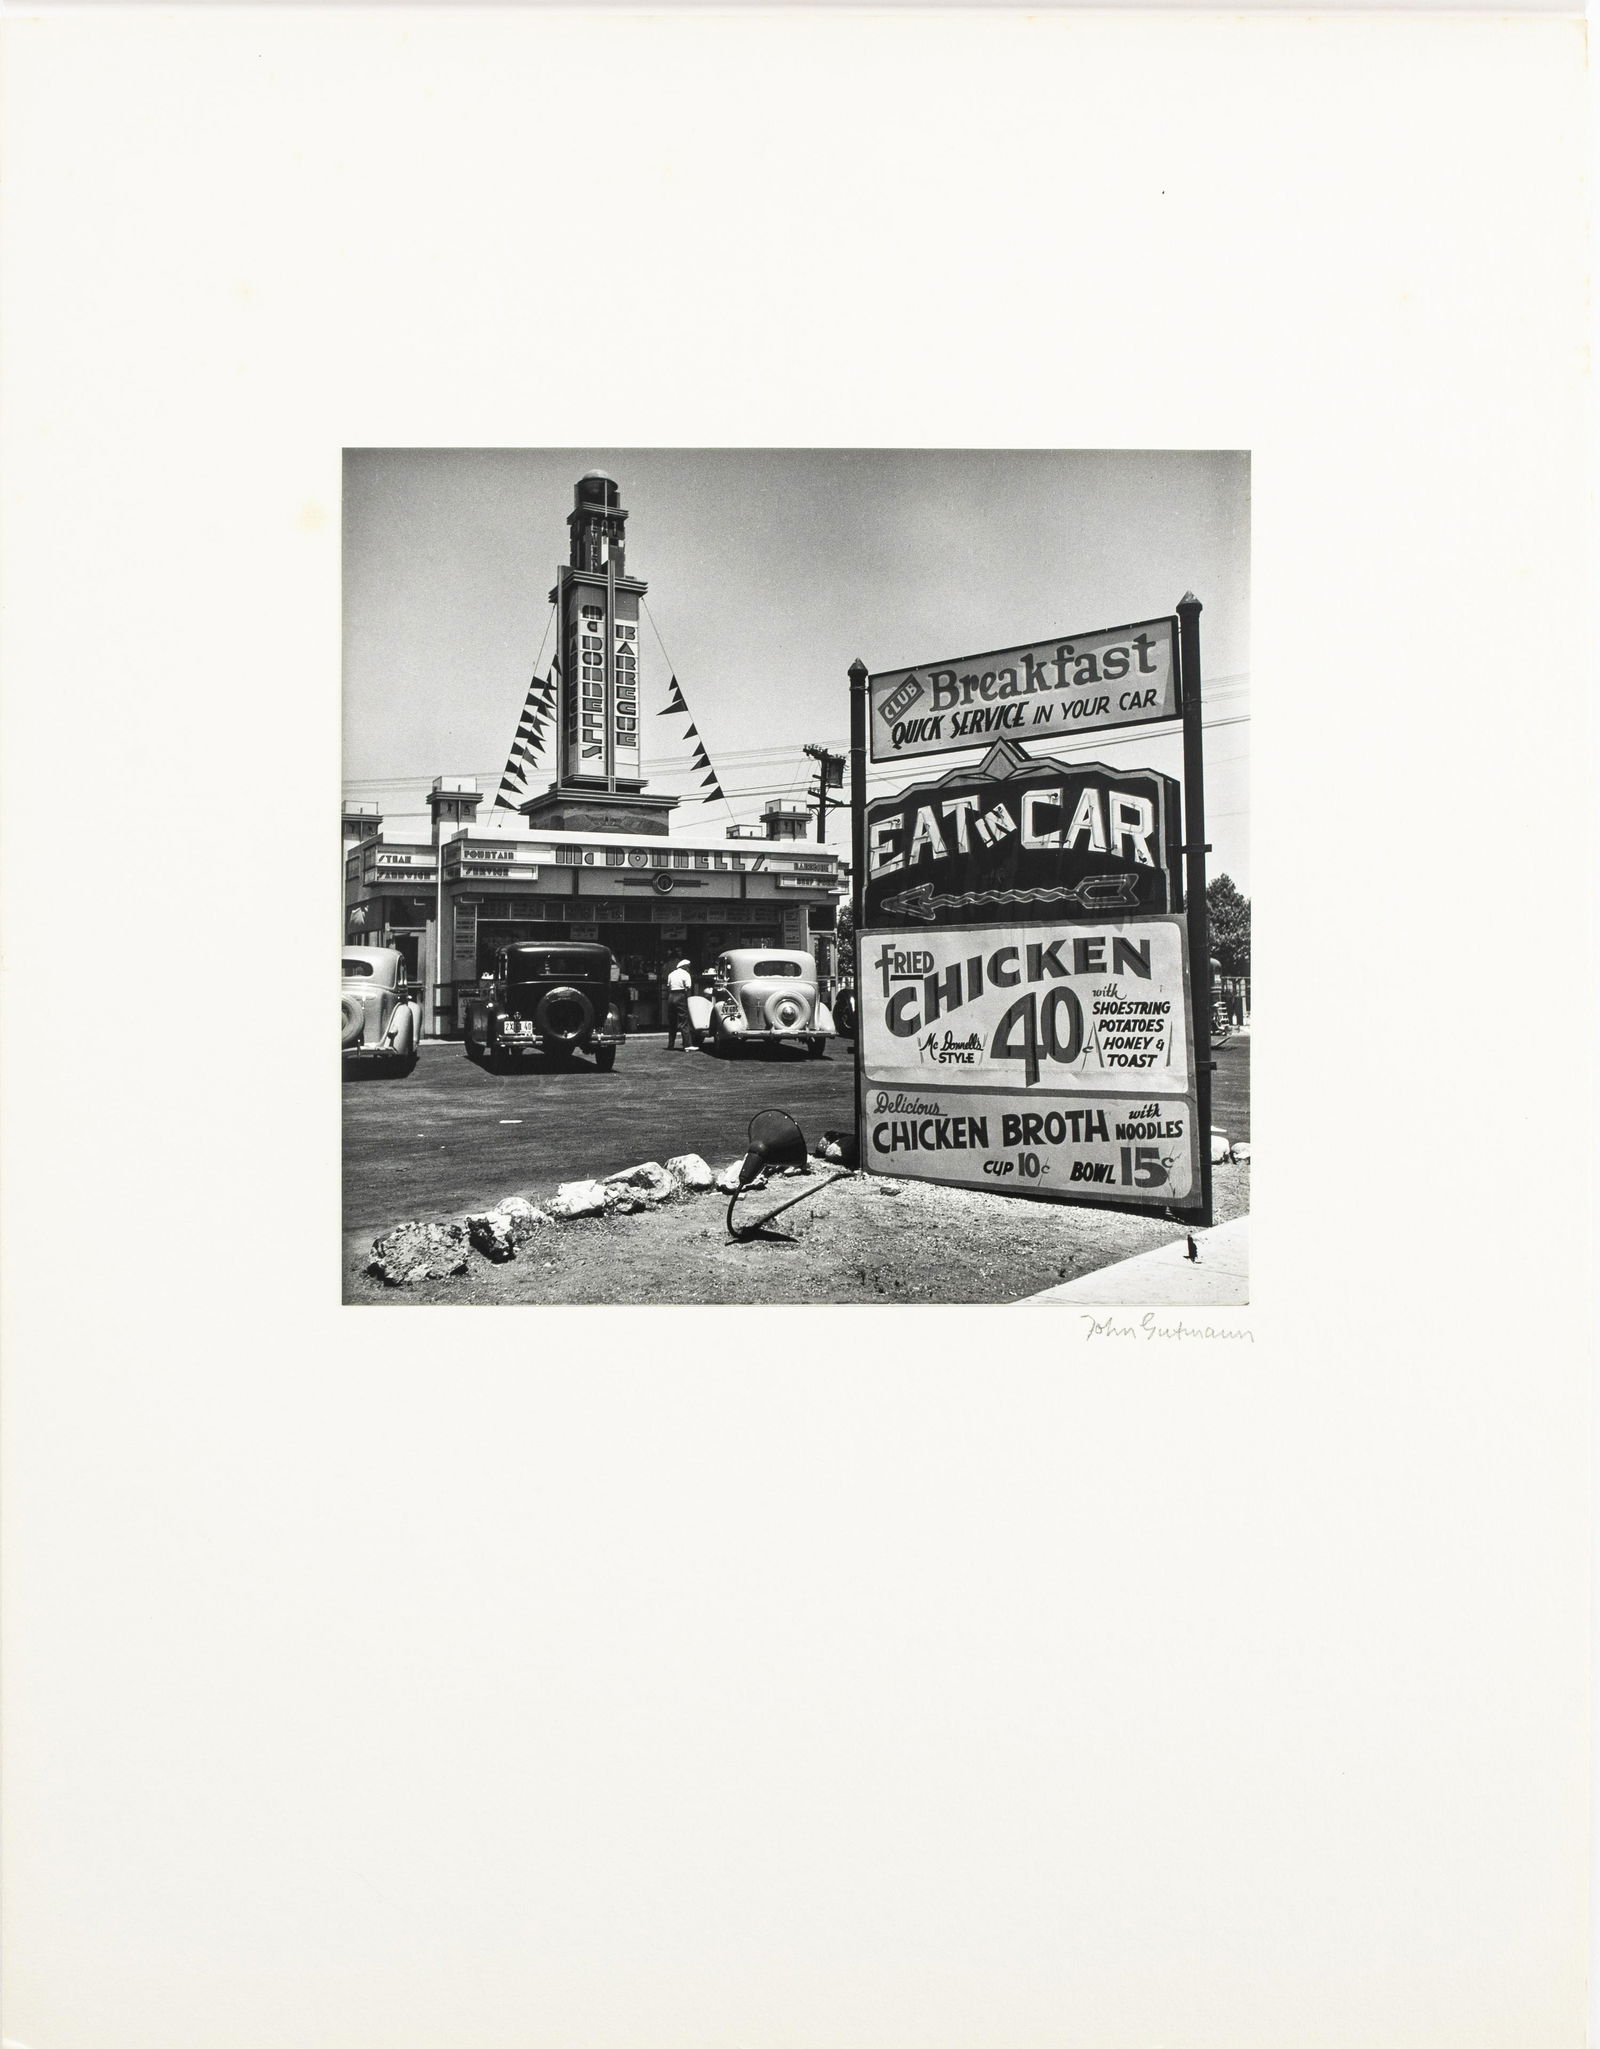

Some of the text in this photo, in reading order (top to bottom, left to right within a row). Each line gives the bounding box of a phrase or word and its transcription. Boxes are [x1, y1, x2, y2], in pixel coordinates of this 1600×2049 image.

[884, 632, 1157, 719] CLUB Breakfast
[892, 688, 1157, 750] QUICK SERVICE IN YOUR CAR
[869, 787, 1156, 880] EAT IN CAR
[463, 850, 514, 860] FOUNTAIN
[874, 944, 934, 997] FRIED
[885, 936, 1152, 1037] CHICKEN
[1092, 983, 1127, 1000] with
[1092, 1001, 1171, 1015] SHOESTRING
[1098, 1019, 1164, 1033] POTATOES
[1102, 1036, 1154, 1050] HONEY
[938, 1052, 974, 1064] STYLE
[1107, 1054, 1158, 1068] TOAST
[873, 1091, 948, 1116] Delicious
[1128, 1103, 1161, 1119] with
[872, 1109, 1110, 1154] CHICKEN BROTH
[1115, 1120, 1183, 1140] NOODLES
[983, 1160, 1014, 1177] CUP
[1070, 1161, 1116, 1184] BOWL
[1080, 1312, 1255, 1343] John Gutmann
